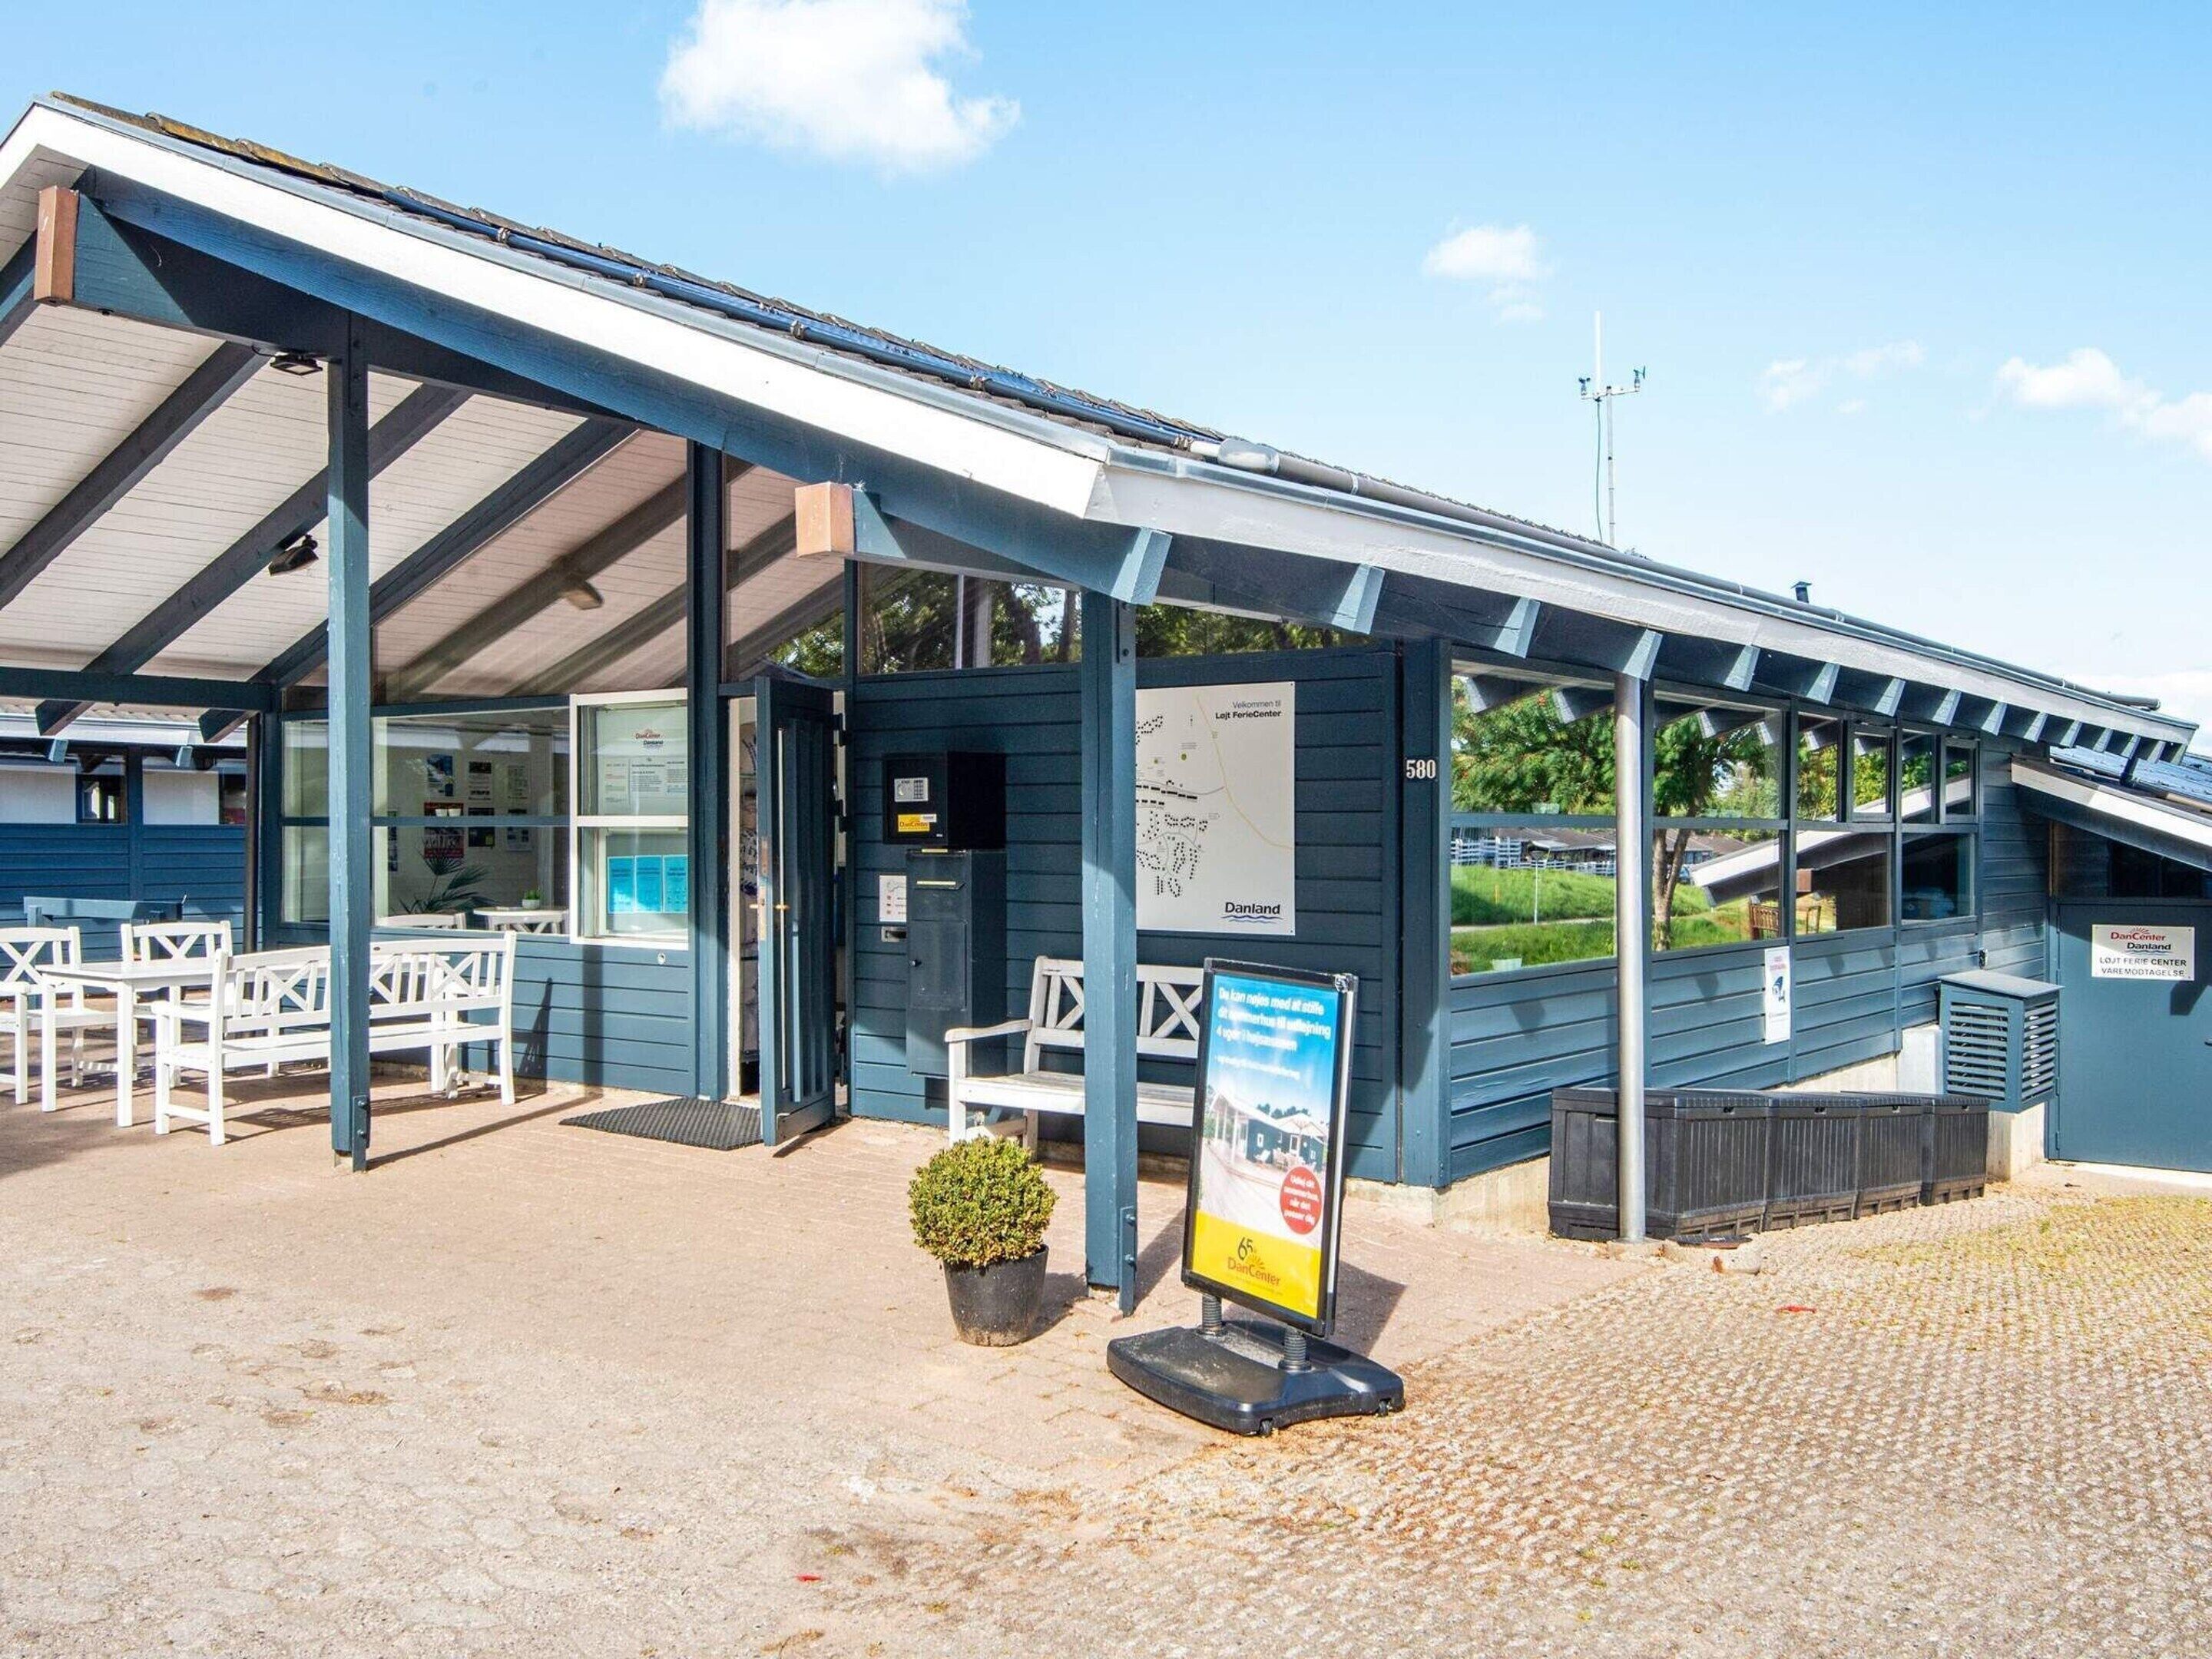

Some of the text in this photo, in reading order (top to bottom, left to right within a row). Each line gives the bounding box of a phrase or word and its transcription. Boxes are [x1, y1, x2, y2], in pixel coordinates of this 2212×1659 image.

[1232, 700, 1273, 709] Velkommen
[1215, 710, 1282, 720] Løjt FerieCenter
[1406, 759, 1437, 780] 580
[1224, 901, 1281, 915] Danland
[2111, 932, 2166, 942] DanCenter
[2127, 942, 2171, 950] Danland
[2123, 957, 2149, 965] FERIE
[2151, 958, 2187, 967] CENTER
[2101, 966, 2185, 978] VAREMODTAGELSE
[1230, 988, 1246, 1002] kan
[1270, 997, 1291, 1010] med
[1237, 1237, 1253, 1261] 65
[1227, 1257, 1281, 1286] DanCenter
